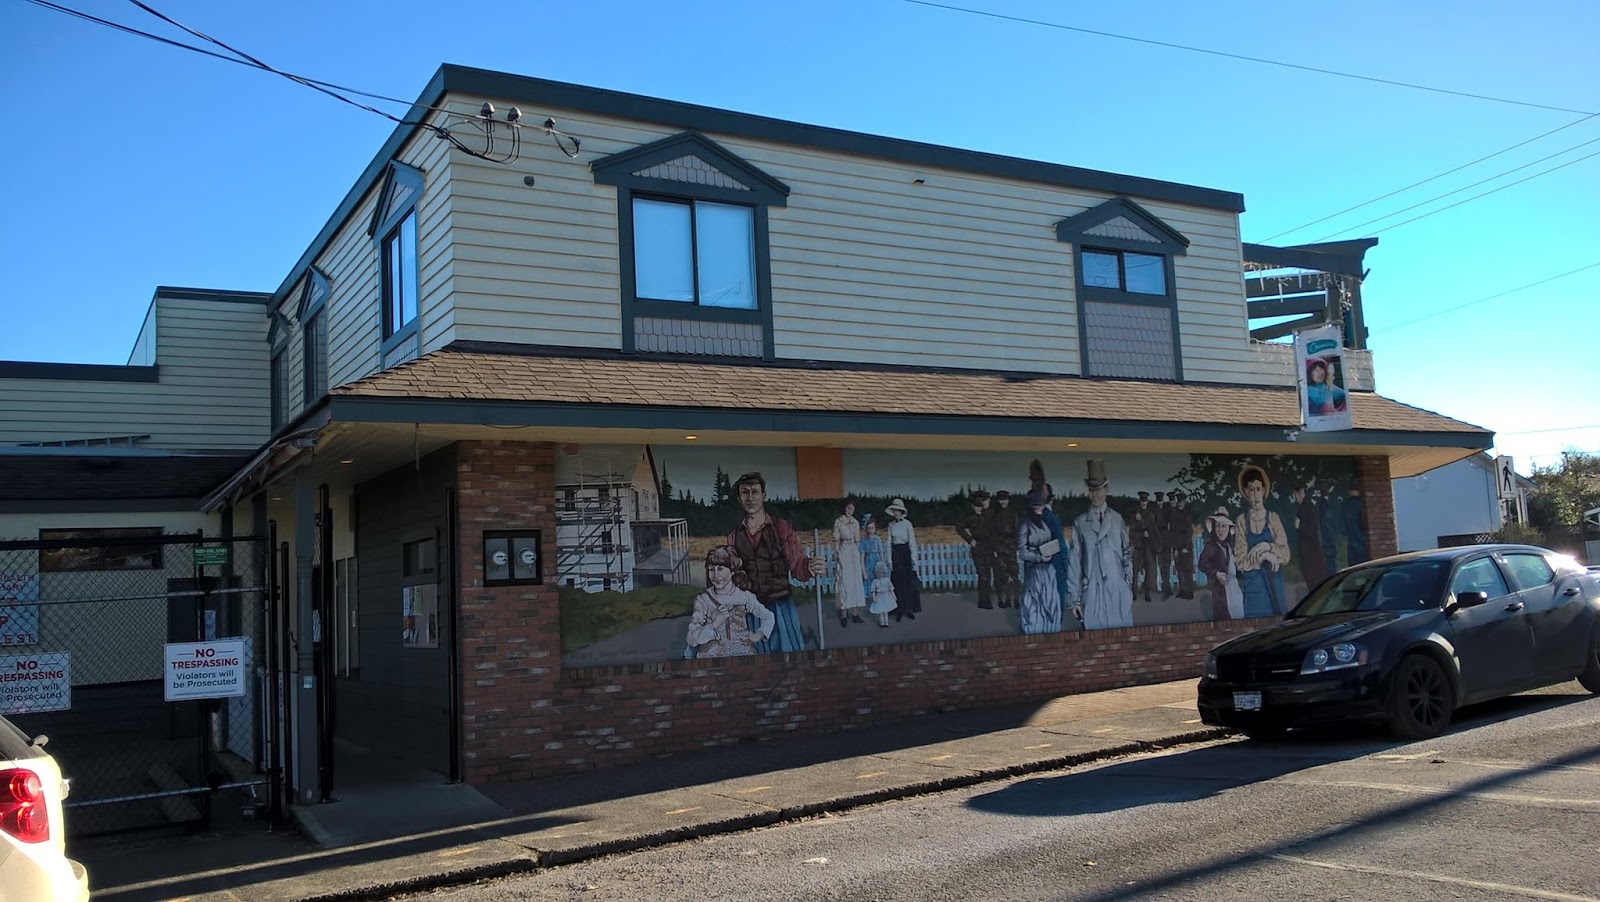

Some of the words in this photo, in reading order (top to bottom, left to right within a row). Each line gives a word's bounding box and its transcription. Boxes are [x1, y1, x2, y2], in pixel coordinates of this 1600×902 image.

[195, 648, 215, 658] NO
[17, 661, 38, 670] NO
[171, 658, 239, 669] TRESPASSING
[0, 670, 64, 682] RESPASSING
[176, 672, 216, 680] Violators
[218, 669, 234, 677] will
[0, 685, 39, 694] iolators
[42, 683, 59, 691] will
[173, 681, 185, 689] be
[187, 677, 237, 688] Prosecuted
[7, 691, 62, 701] Prosecuted
